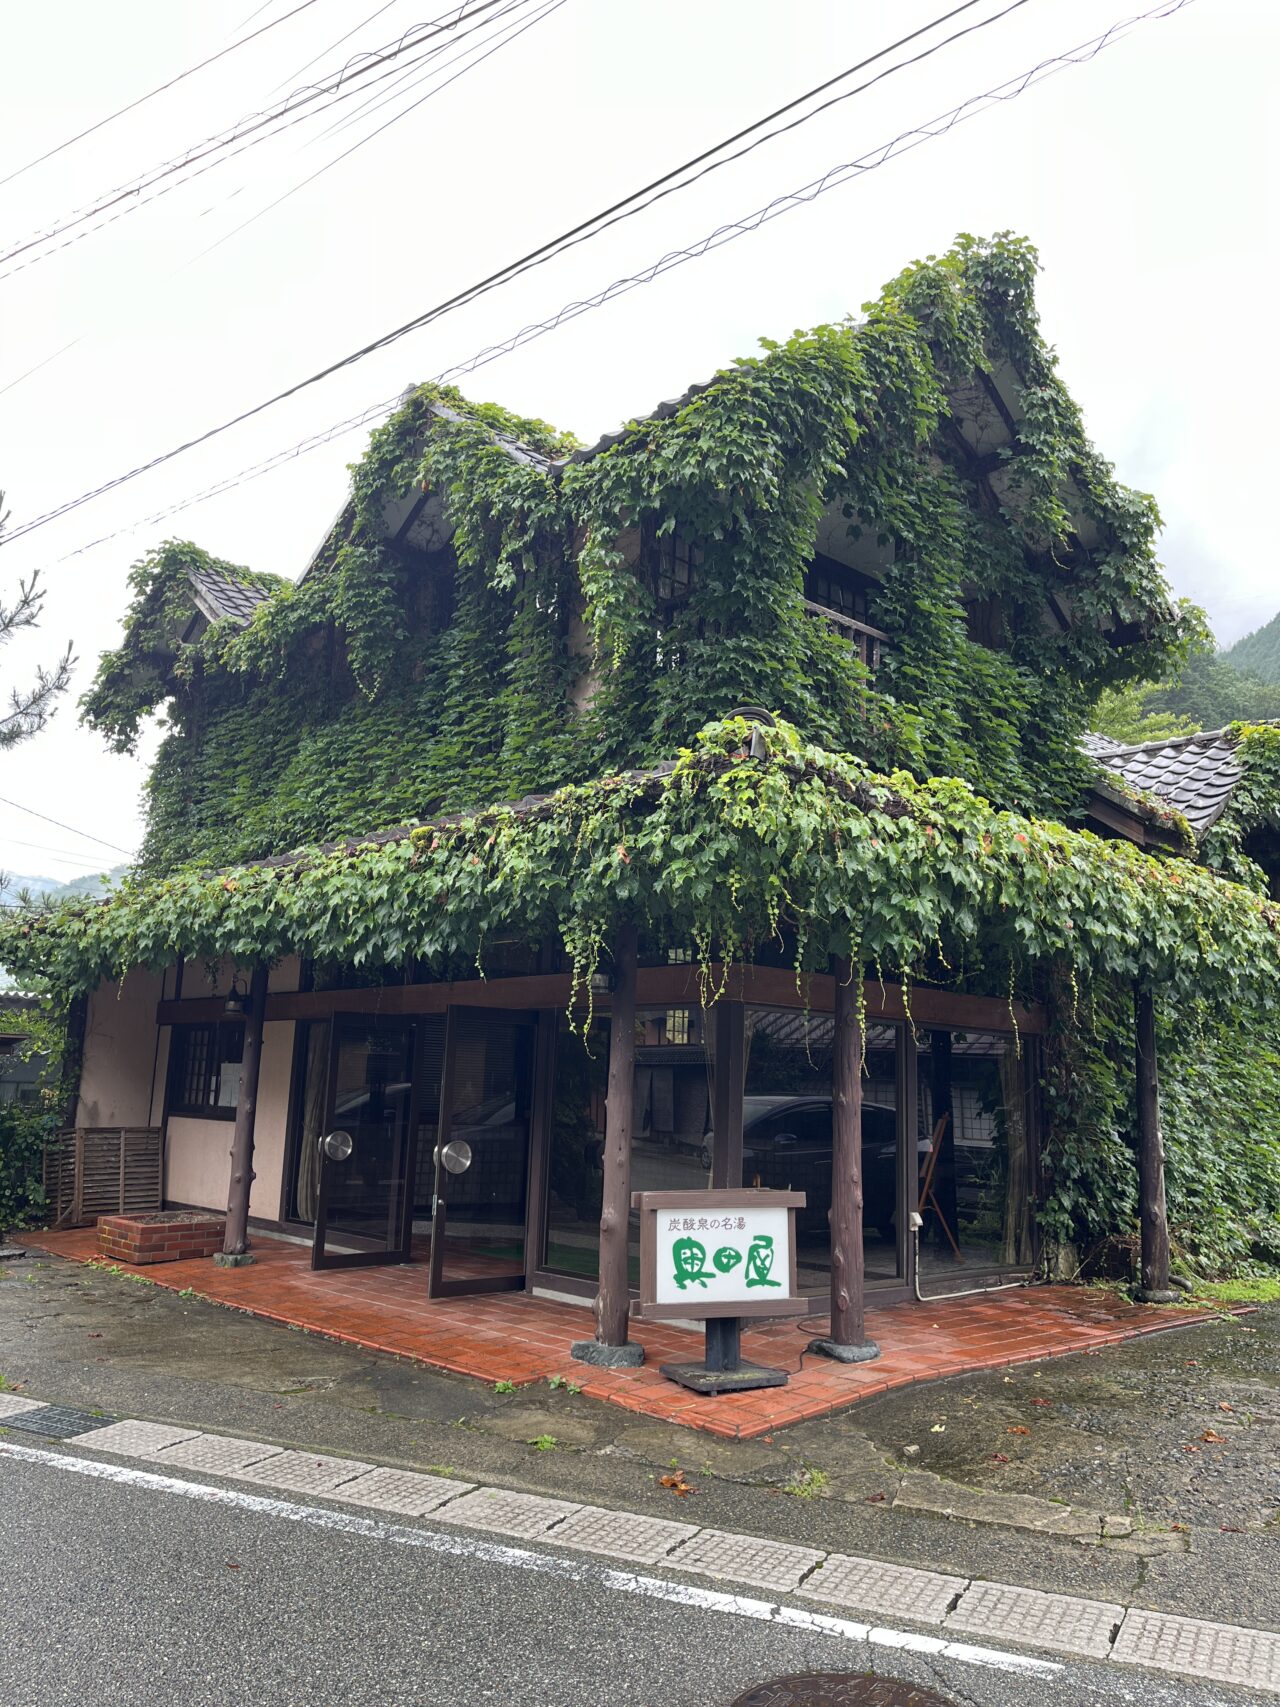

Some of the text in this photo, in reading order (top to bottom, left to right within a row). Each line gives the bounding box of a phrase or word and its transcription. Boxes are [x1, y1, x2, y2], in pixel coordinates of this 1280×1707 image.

[668, 1216, 746, 1231] 炭酸泉の名湯
